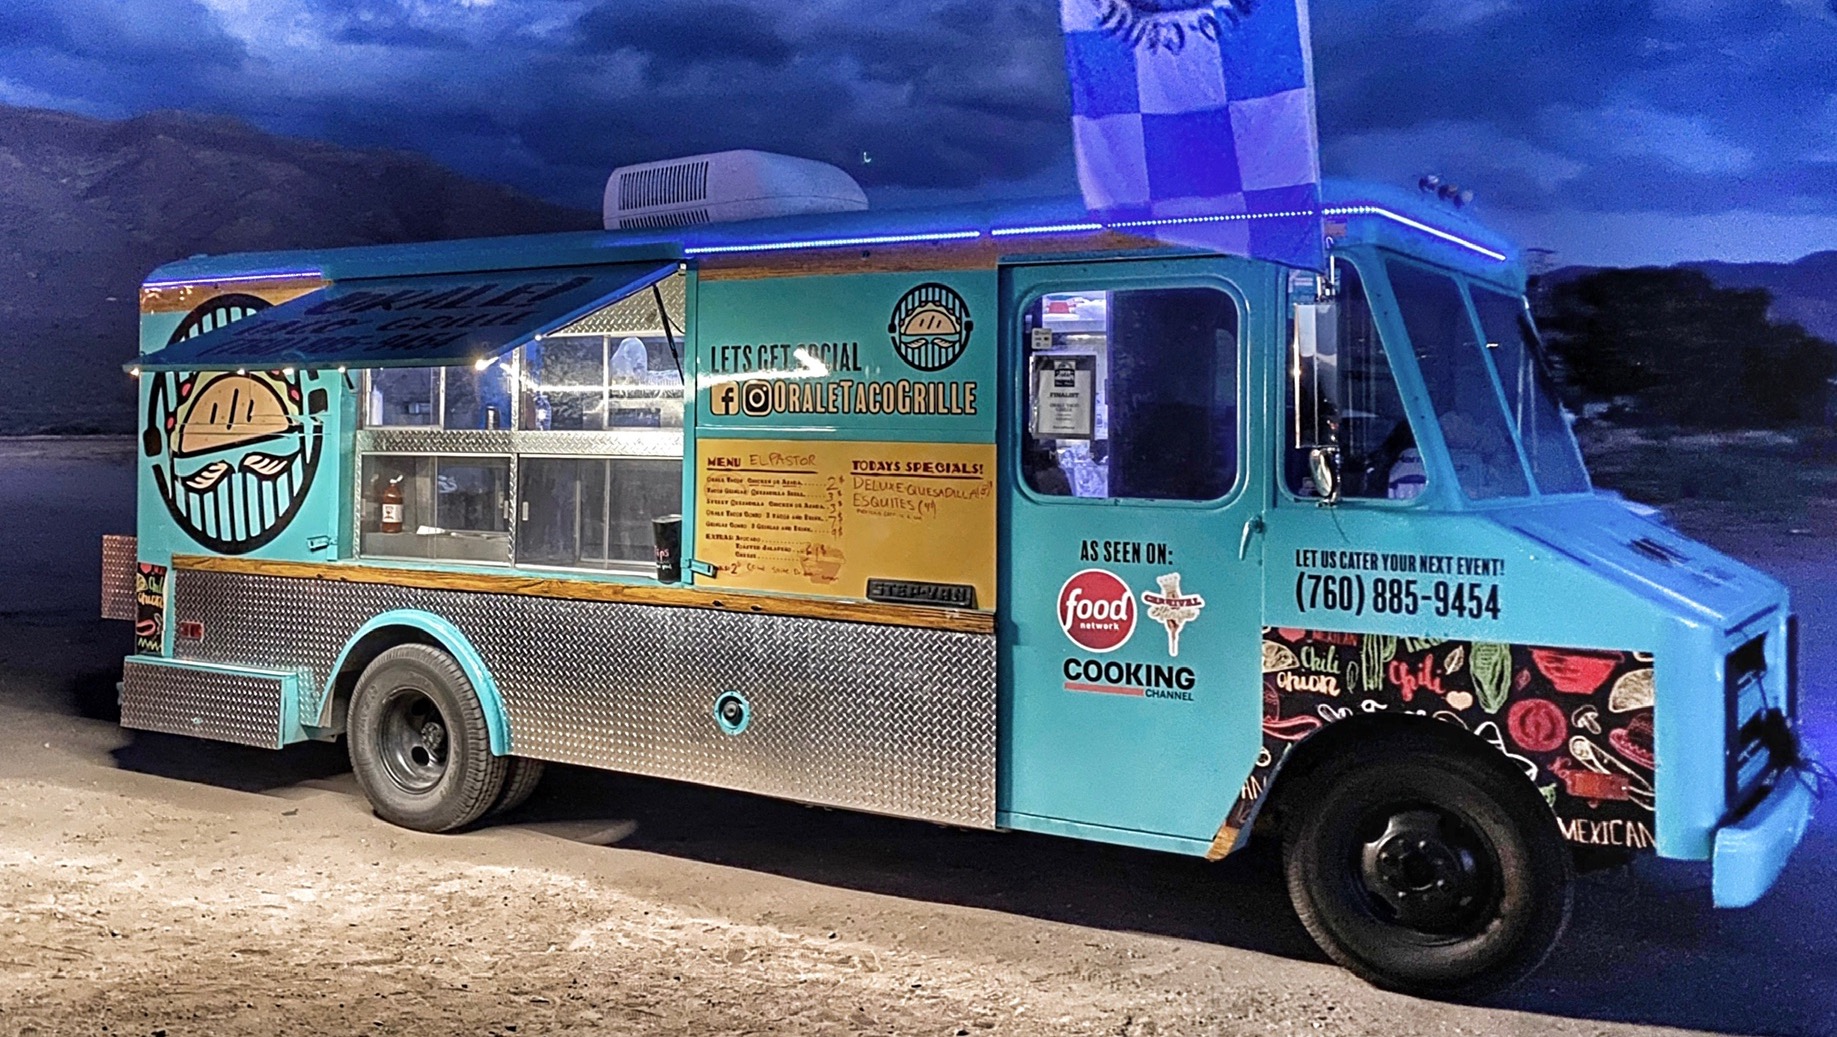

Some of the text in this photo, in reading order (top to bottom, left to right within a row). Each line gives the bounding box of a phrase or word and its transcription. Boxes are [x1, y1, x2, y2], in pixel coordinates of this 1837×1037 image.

[711, 345, 752, 373] LETS
[758, 344, 791, 371] GET
[707, 457, 741, 467] MENU
[852, 460, 984, 474] TODAYS SPECIALS!
[853, 476, 905, 493] DELUXE
[853, 492, 915, 511] ESQUITES
[1080, 540, 1173, 565] AS SEEN ON:
[1296, 549, 1505, 576] LET US CATER YOUR NEXT EVENT!
[1064, 588, 1128, 630] food
[1296, 571, 1501, 620] (760) 885-9454
[1080, 622, 1119, 630] network
[1301, 645, 1340, 675] Chili
[1063, 658, 1196, 690] COOKING
[1389, 653, 1446, 702] Chili
[1145, 688, 1195, 701] CHANNEL
[1556, 816, 1657, 849] MEXICAN
